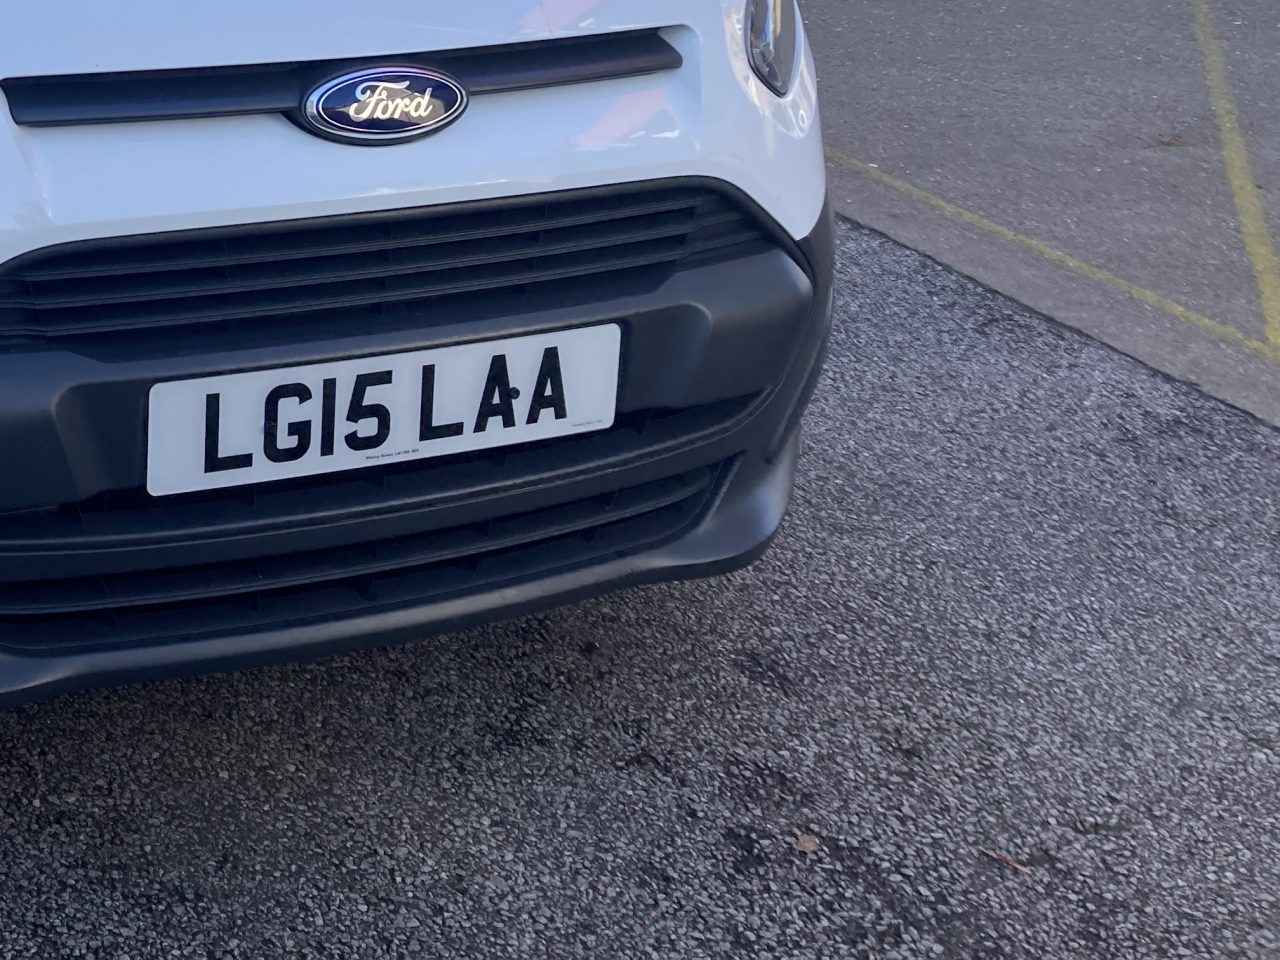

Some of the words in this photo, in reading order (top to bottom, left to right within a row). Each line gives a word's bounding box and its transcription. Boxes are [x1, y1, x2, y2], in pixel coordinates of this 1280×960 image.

[349, 80, 433, 122] Ford
[204, 370, 393, 473] LG15
[419, 346, 567, 442] LAA
